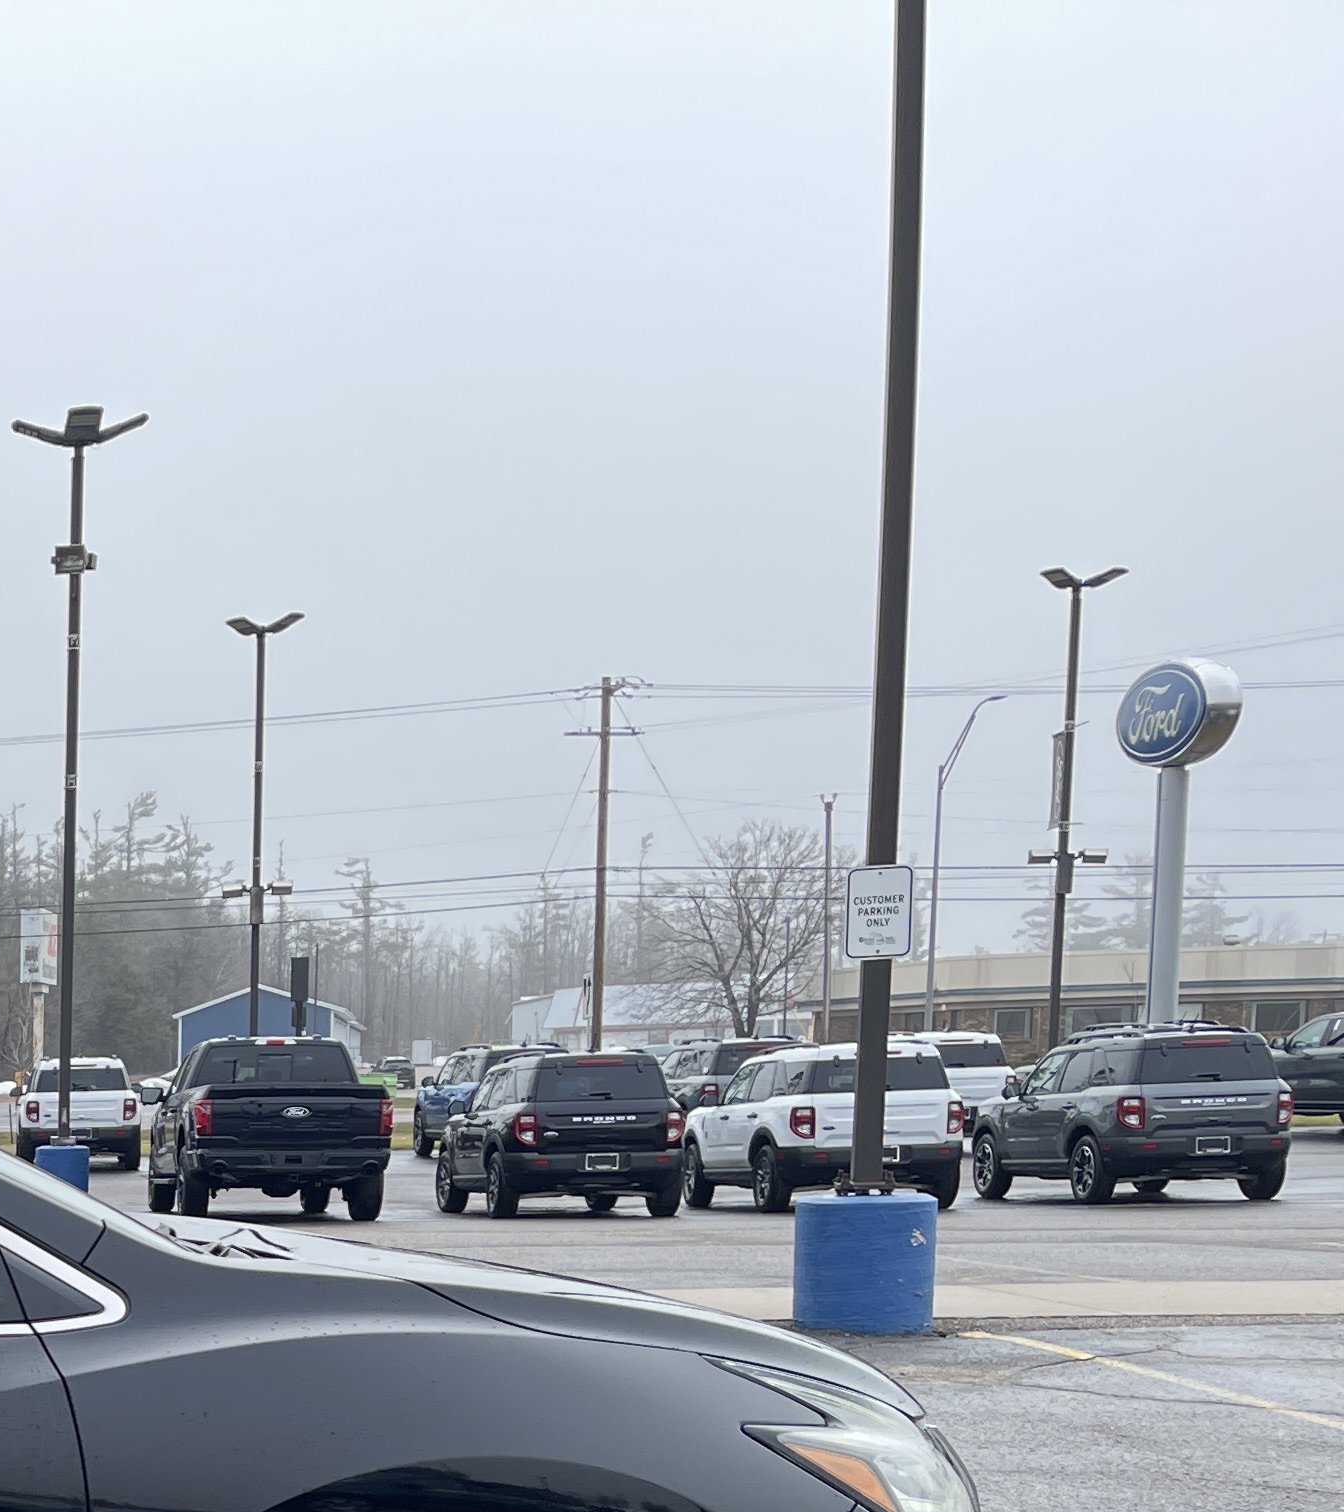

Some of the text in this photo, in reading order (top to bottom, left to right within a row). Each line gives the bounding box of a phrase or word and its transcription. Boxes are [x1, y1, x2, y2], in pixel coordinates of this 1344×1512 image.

[1128, 683, 1185, 745] Ford
[853, 894, 905, 906] CUSTOMER
[858, 906, 900, 917] PARKING
[866, 917, 891, 928] ONLY
